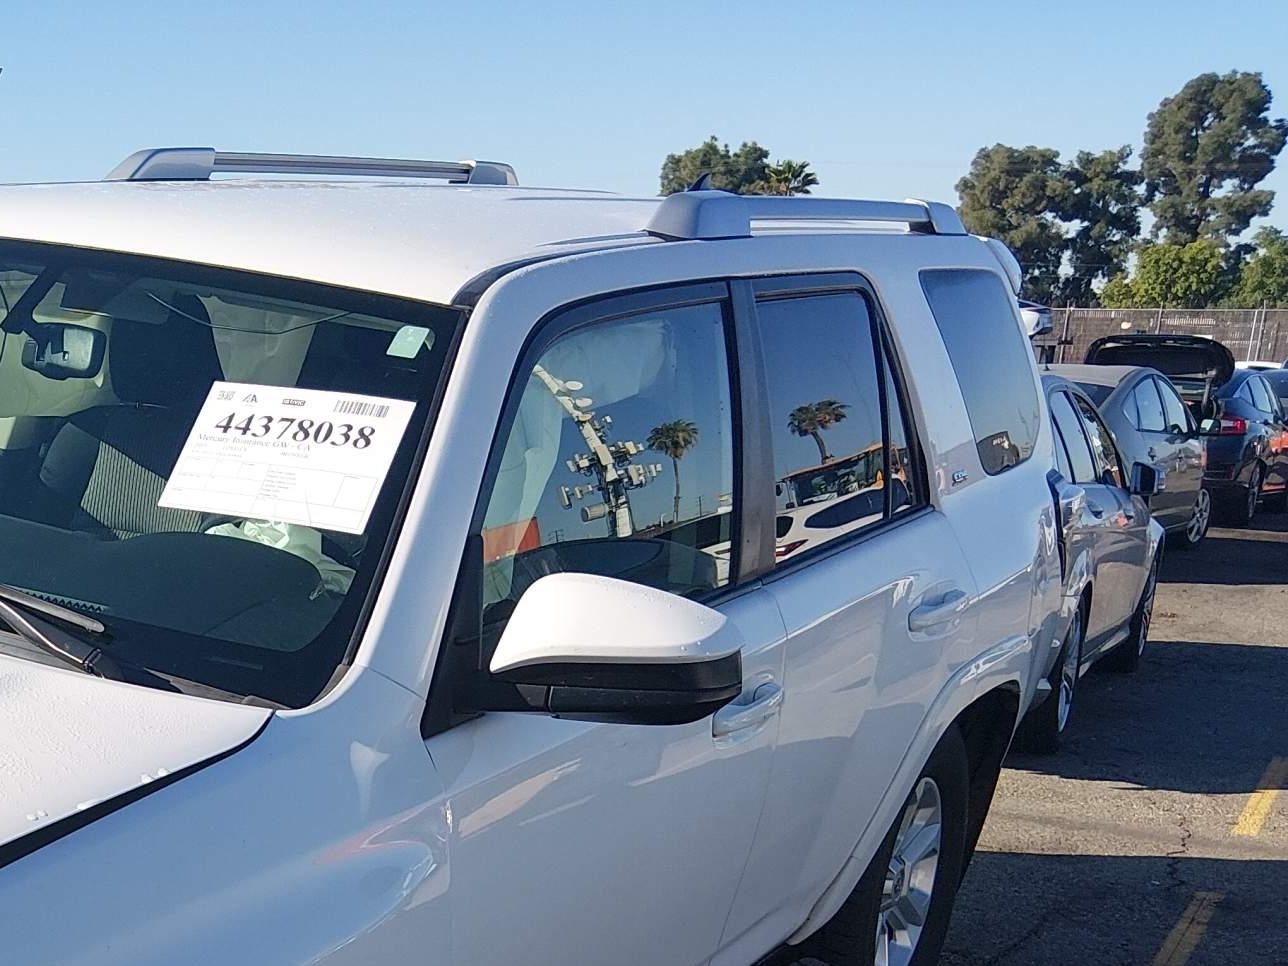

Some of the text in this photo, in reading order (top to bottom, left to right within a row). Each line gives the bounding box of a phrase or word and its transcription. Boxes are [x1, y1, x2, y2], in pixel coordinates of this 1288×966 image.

[199, 433, 230, 444] Mercury
[232, 437, 270, 448] Insurance
[214, 412, 376, 450] 44378038
